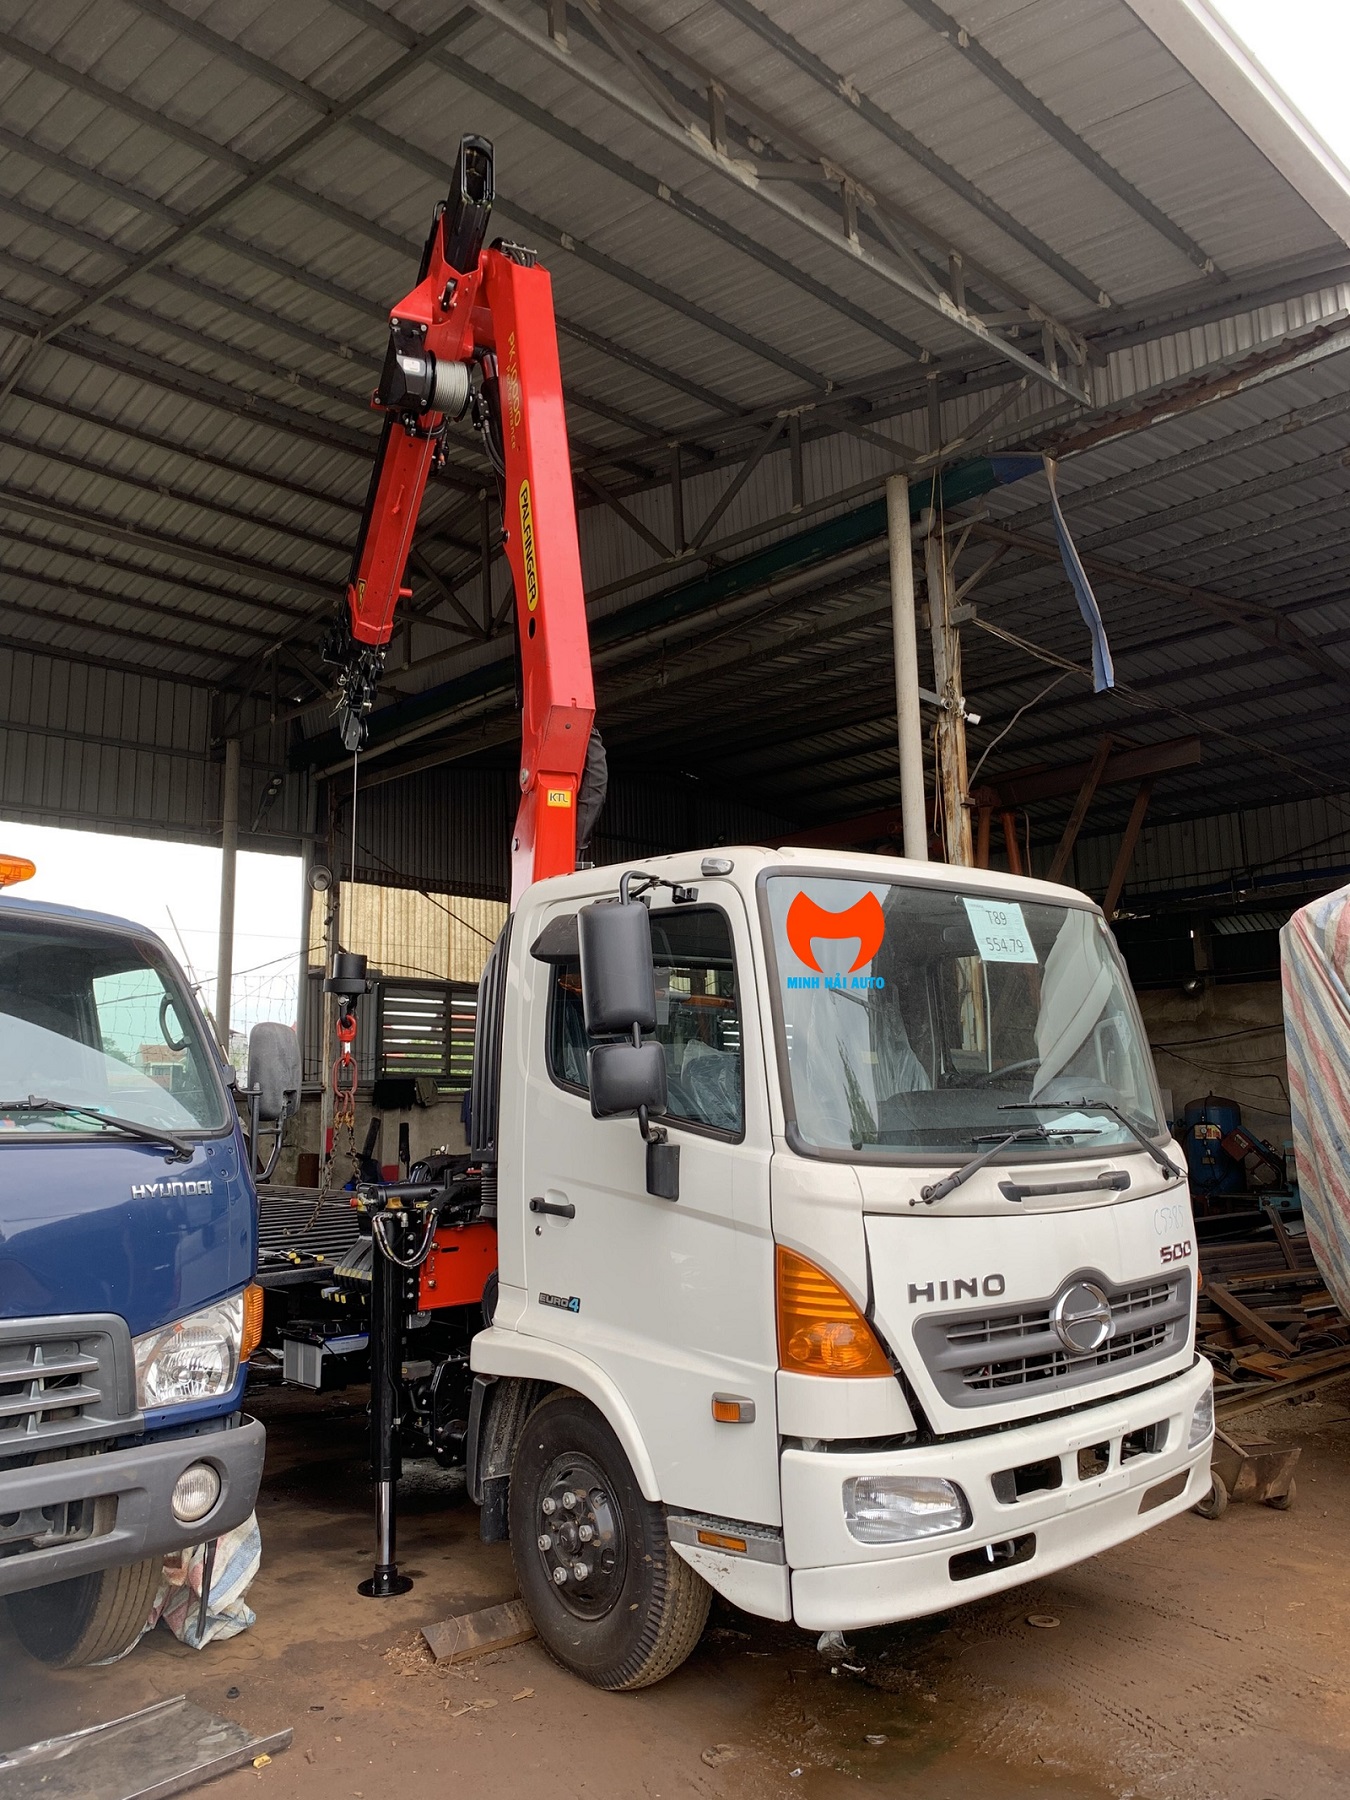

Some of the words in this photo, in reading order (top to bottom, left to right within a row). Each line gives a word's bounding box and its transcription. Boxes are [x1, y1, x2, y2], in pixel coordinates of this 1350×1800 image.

[520, 486, 537, 604] PALFINGER
[985, 910, 1008, 926] T89
[985, 937, 1025, 953] 554.79
[131, 1180, 213, 1201] HYUNDAI
[1159, 1239, 1192, 1264] 500
[907, 1273, 1006, 1304] HINO
